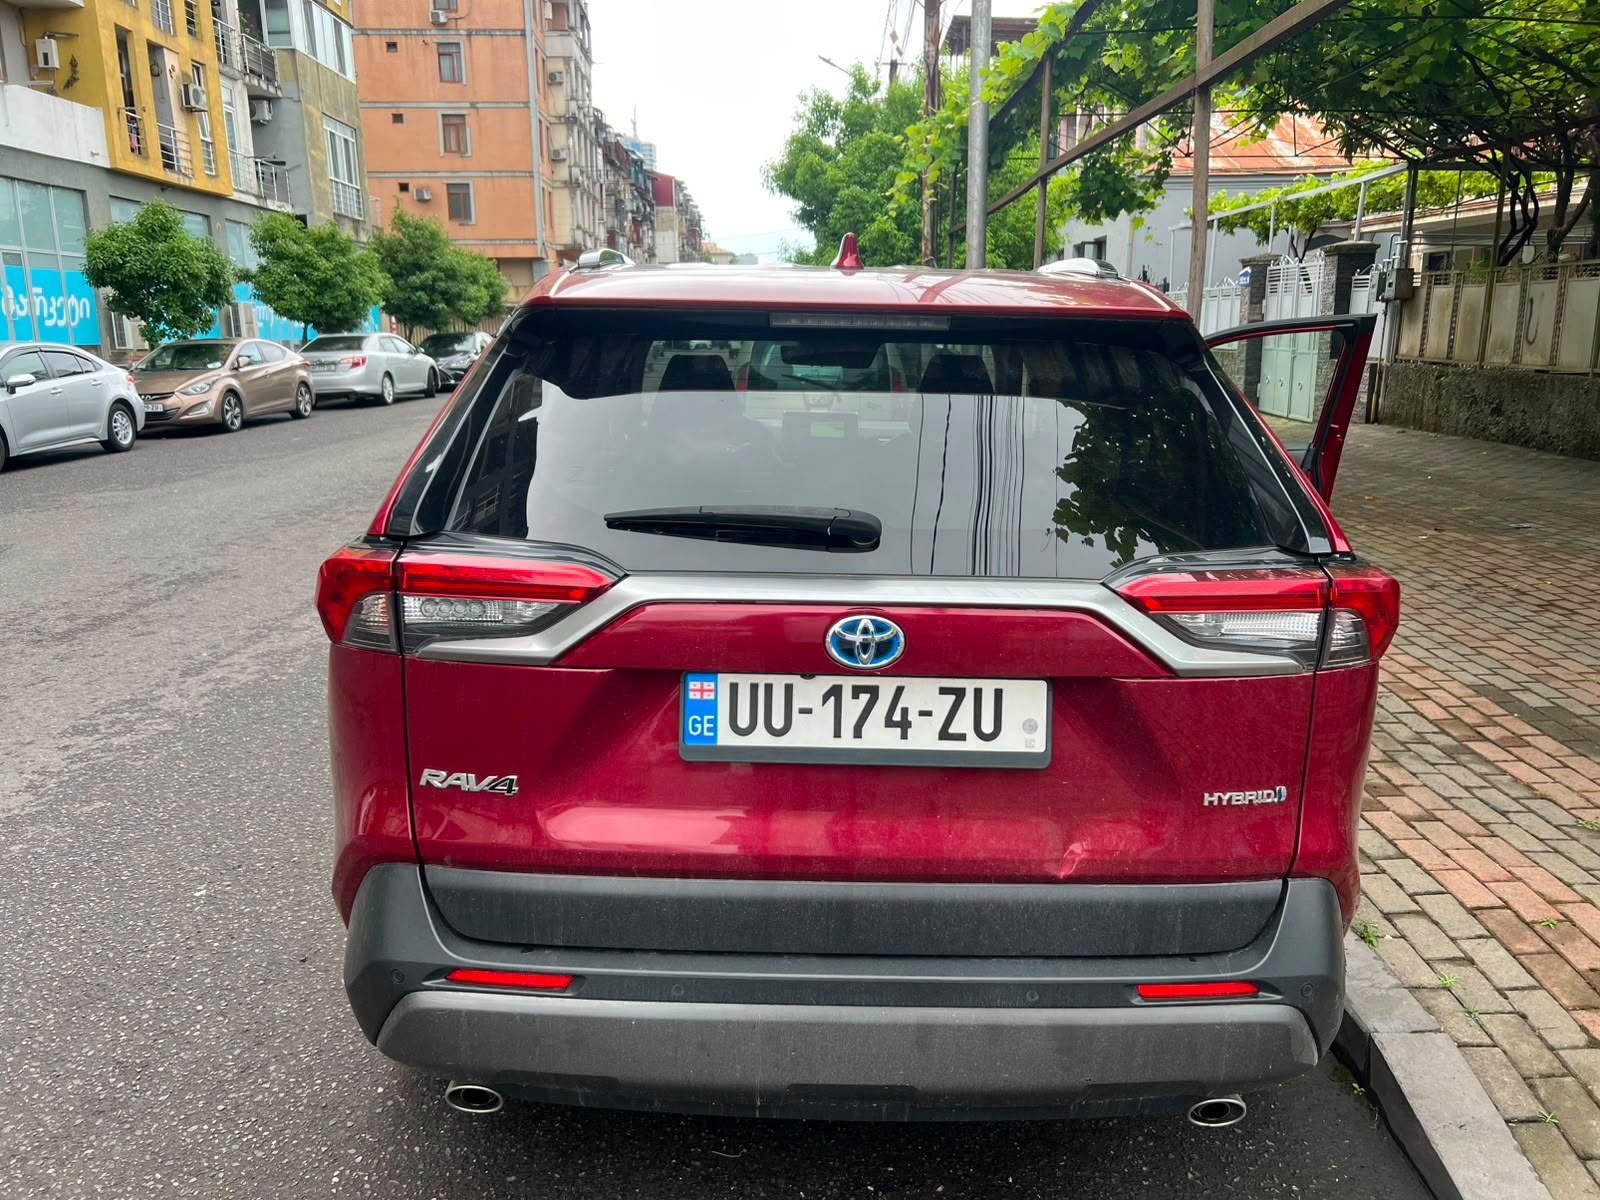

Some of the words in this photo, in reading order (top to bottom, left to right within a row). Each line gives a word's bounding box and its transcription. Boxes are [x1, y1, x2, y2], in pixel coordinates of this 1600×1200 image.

[728, 682, 1004, 742] UU-174-ZU
[688, 715, 715, 736] GE
[419, 768, 519, 796] RAV4
[1203, 789, 1275, 806] HYBRID
